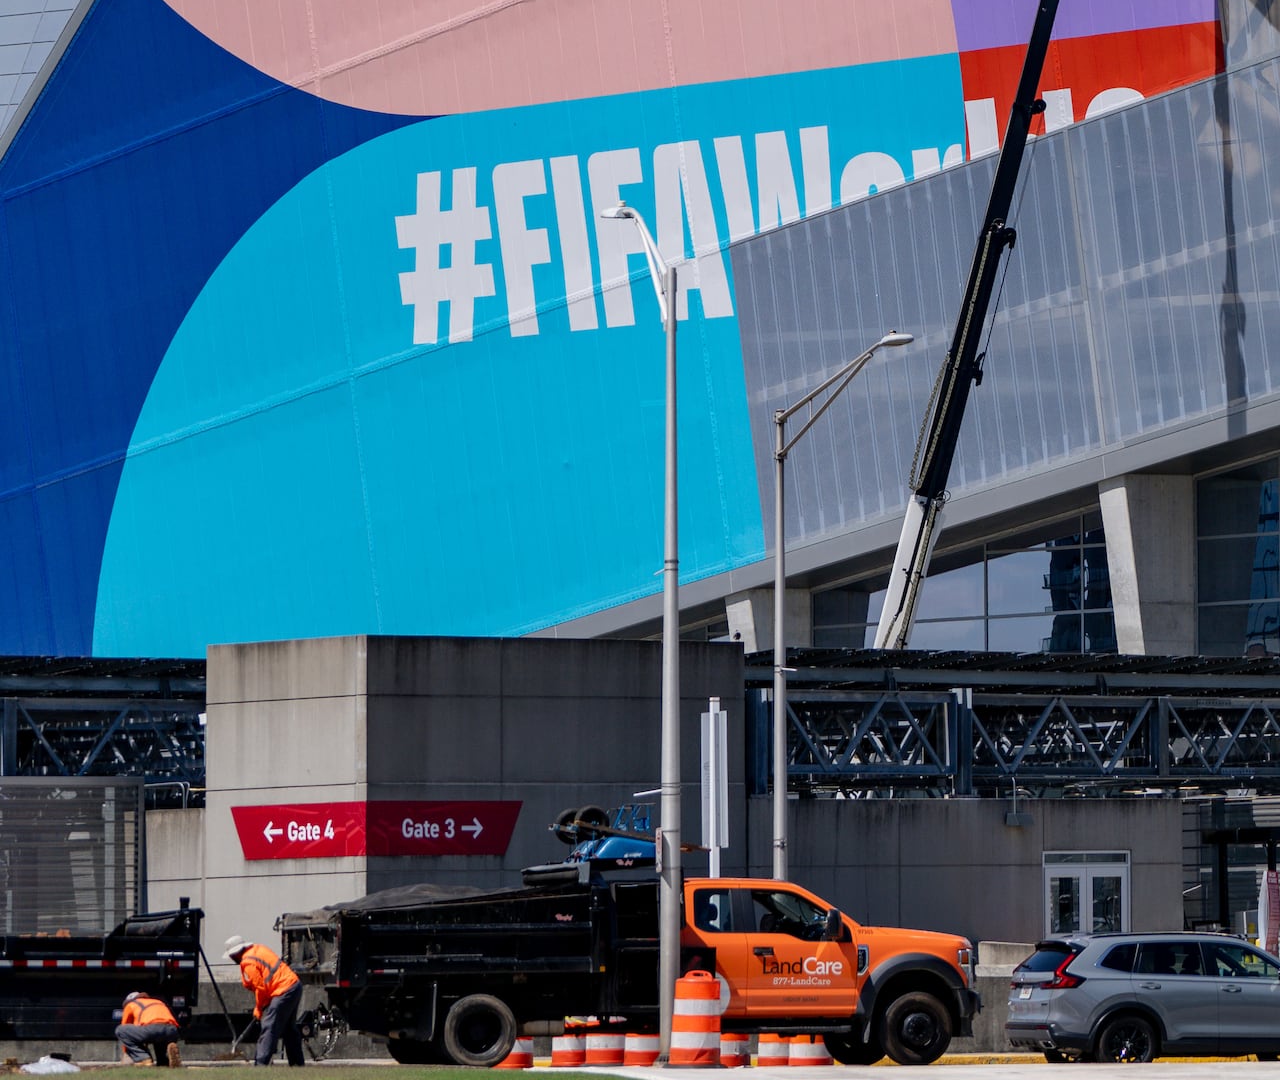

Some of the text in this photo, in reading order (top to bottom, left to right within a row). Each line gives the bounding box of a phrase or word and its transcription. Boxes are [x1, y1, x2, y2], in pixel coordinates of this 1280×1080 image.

[288, 819, 335, 842] Gate 4
[402, 818, 456, 839] Gate 3
[762, 956, 843, 975] LandCare
[772, 976, 831, 986] 877-LandCare
